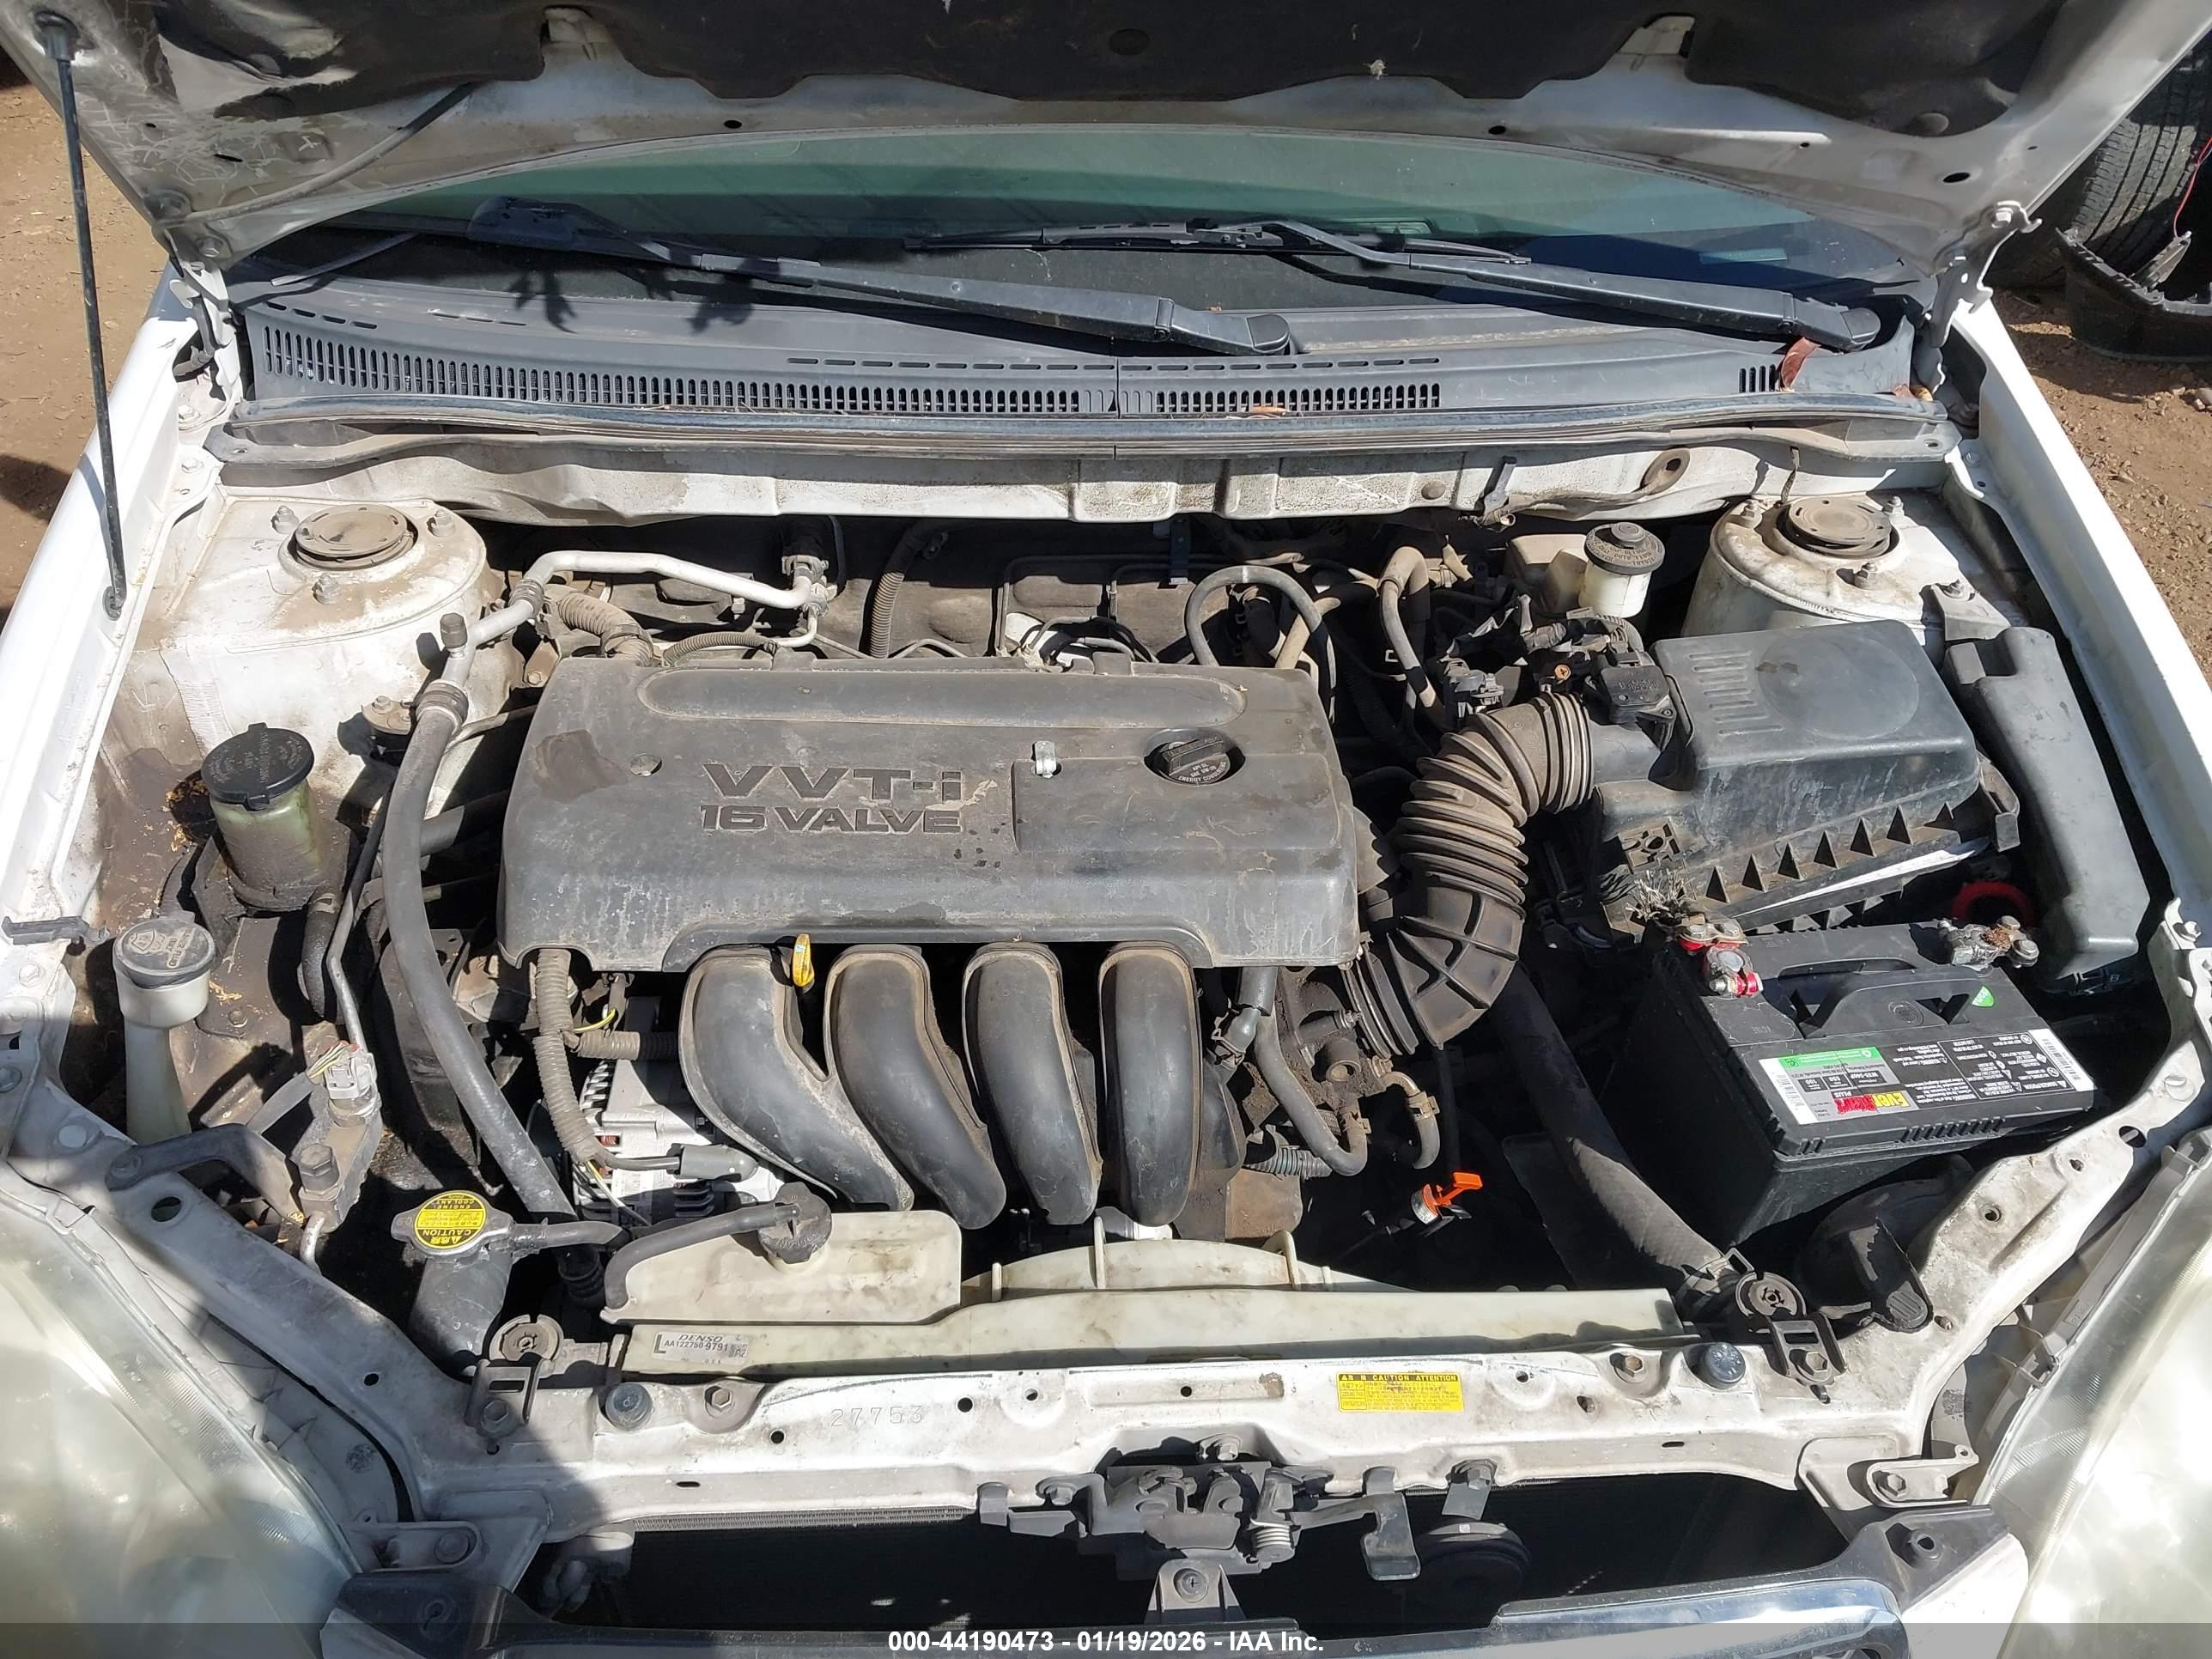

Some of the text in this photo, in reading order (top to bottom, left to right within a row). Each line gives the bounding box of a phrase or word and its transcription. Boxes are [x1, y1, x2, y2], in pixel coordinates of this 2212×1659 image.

[702, 763, 963, 801] VVT-i
[700, 805, 963, 835] 16 VALVE
[1833, 1090, 1852, 1098] PLUS
[678, 1334, 724, 1343] DENSO
[706, 1342, 728, 1352] 9791
[830, 1405, 922, 1427] 27753
